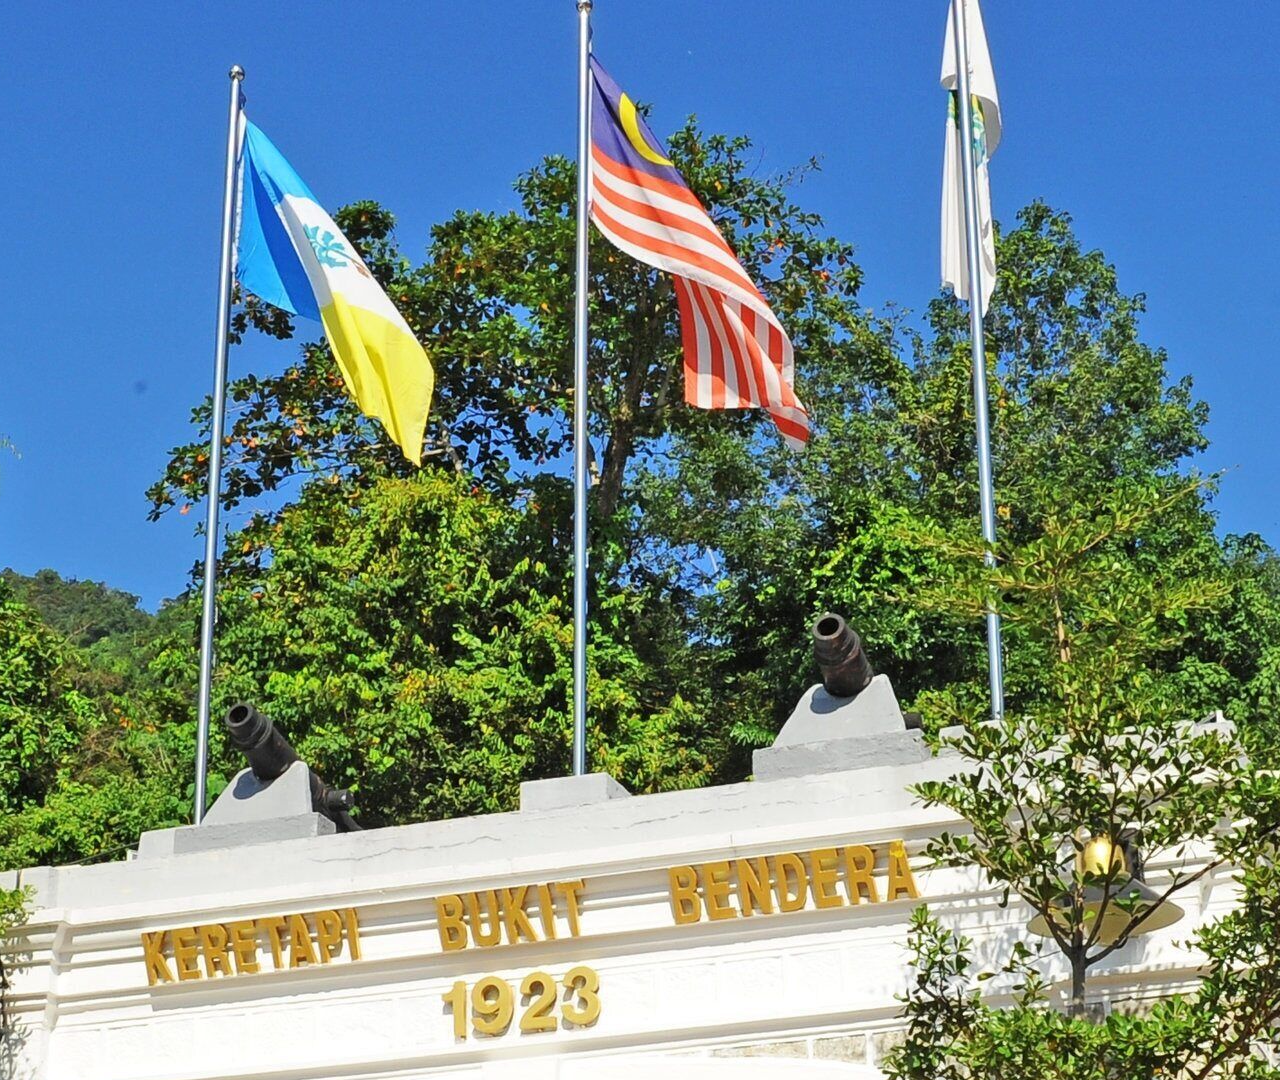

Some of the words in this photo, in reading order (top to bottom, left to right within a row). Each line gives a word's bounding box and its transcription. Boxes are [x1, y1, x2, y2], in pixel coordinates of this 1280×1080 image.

[141, 907, 362, 986] KERETAPI
[436, 879, 585, 952] BUKIT
[668, 838, 921, 925] BENDERA
[442, 966, 602, 1041] 1923
